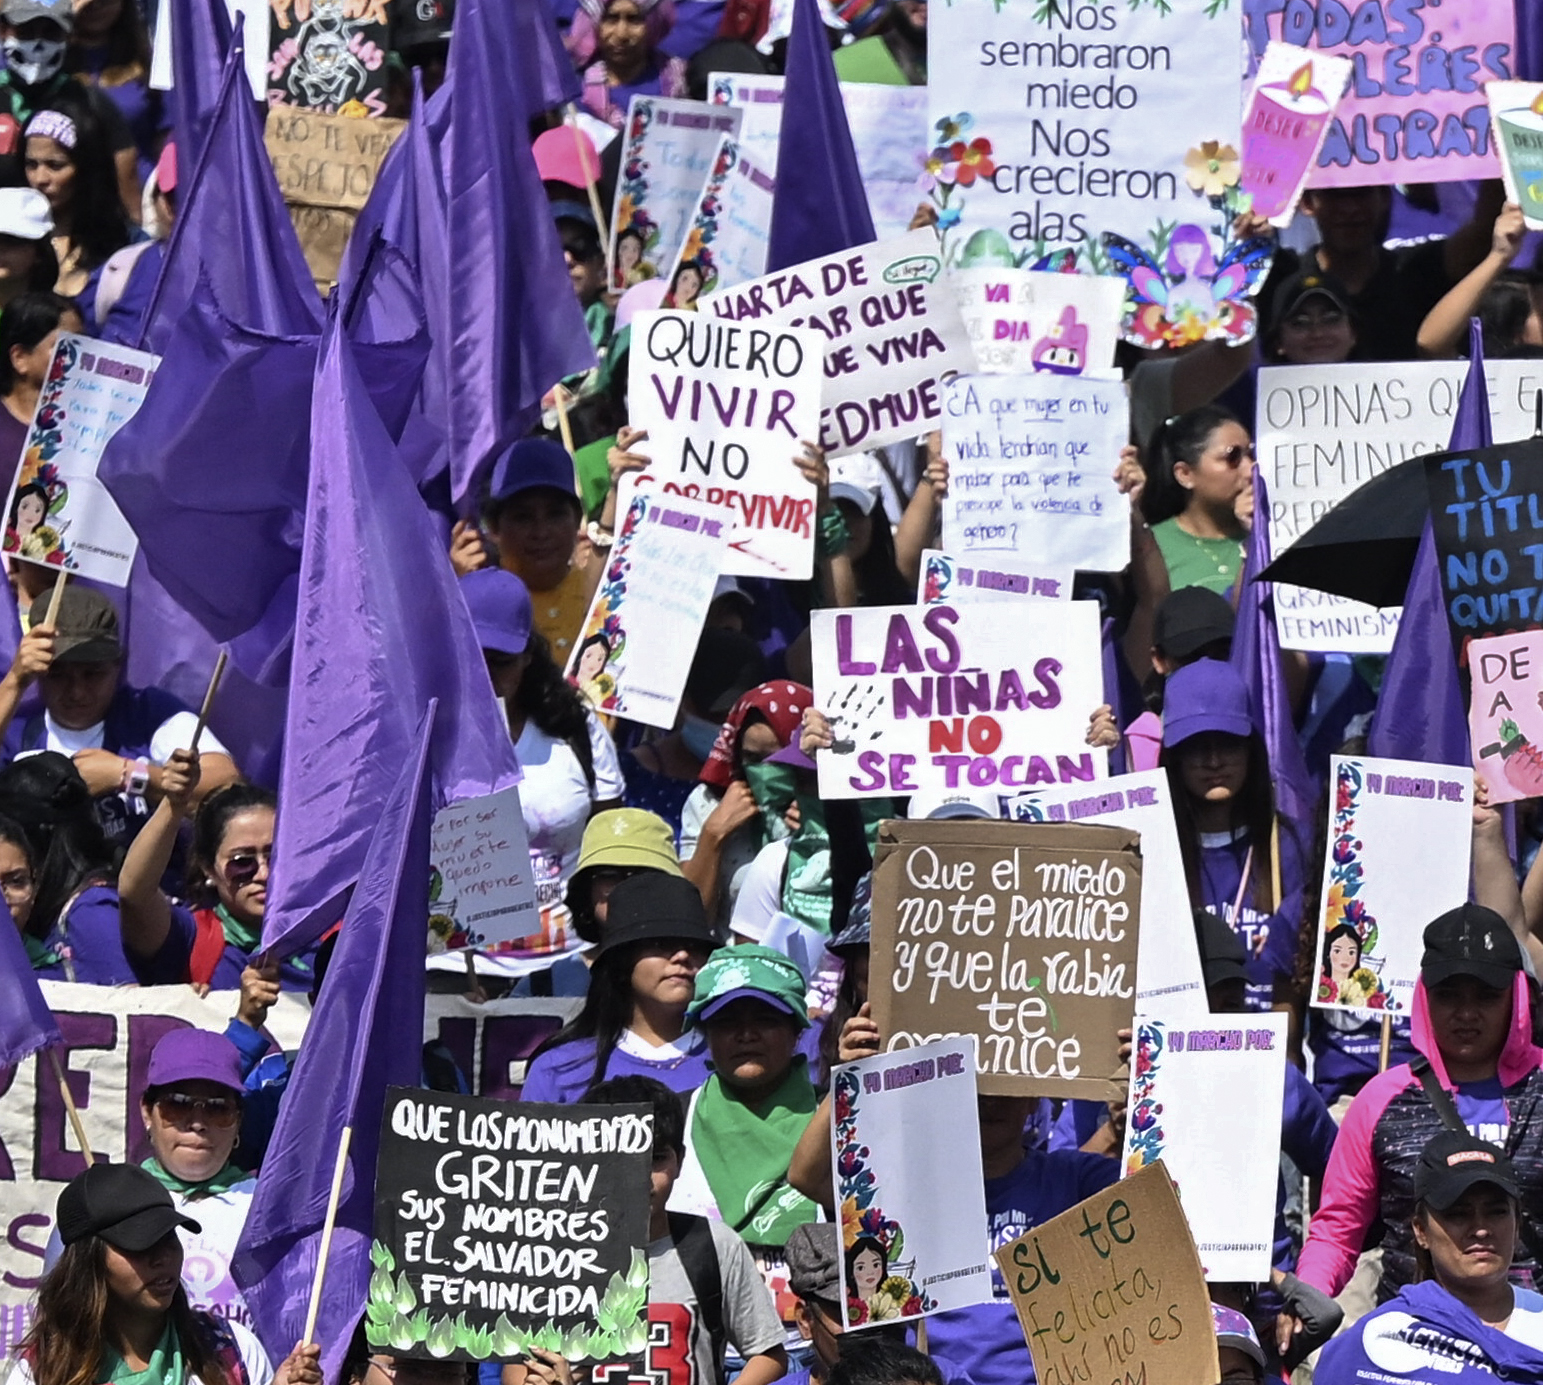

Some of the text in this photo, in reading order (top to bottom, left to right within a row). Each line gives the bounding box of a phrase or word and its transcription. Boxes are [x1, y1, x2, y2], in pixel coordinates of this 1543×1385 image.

[981, 35, 1170, 71] sembraron
[1026, 74, 1137, 110] miedo
[275, 116, 308, 142] NO
[1030, 119, 1110, 158] Nos
[991, 160, 1176, 200] crecieron
[1008, 202, 1087, 244] alas
[713, 257, 867, 320] HARTA DE
[859, 284, 927, 332] QUE
[647, 316, 804, 380] QUIERO
[872, 328, 945, 369] VIVA
[651, 373, 798, 439] VIVIR
[990, 395, 1109, 430] que en tu
[1266, 380, 1414, 430] OPINAS
[681, 436, 750, 481] NO
[956, 431, 1090, 467] vida que
[1039, 473, 1060, 494] que
[1067, 471, 1082, 487] te
[1440, 458, 1510, 498] TU
[1447, 548, 1510, 587] NO
[836, 606, 959, 675] LAS
[1481, 647, 1530, 685] DE
[892, 658, 1062, 718] NIÑAS
[929, 716, 1002, 754] NO
[849, 753, 1095, 790] SE TOCAN
[1384, 775, 1435, 798] MARCHO
[906, 846, 1126, 897] Que el miedo
[897, 893, 996, 937] no te
[892, 939, 1135, 1005] y que la rabia
[976, 991, 1048, 1036] te
[1168, 1032, 1185, 1053] YO
[1187, 1030, 1242, 1052] MARCHO
[864, 1071, 882, 1094] YO
[884, 1061, 935, 1092] MARCHO
[391, 1098, 654, 1154] QUE LOS MONUMENTOS
[435, 1150, 599, 1203] GRITEN
[462, 1203, 609, 1242] NOMBRES
[1071, 1198, 1137, 1262] te
[454, 1236, 607, 1280] SALVADOR
[421, 1274, 599, 1316] FEMINICIDA
[1102, 1304, 1184, 1367] no es
